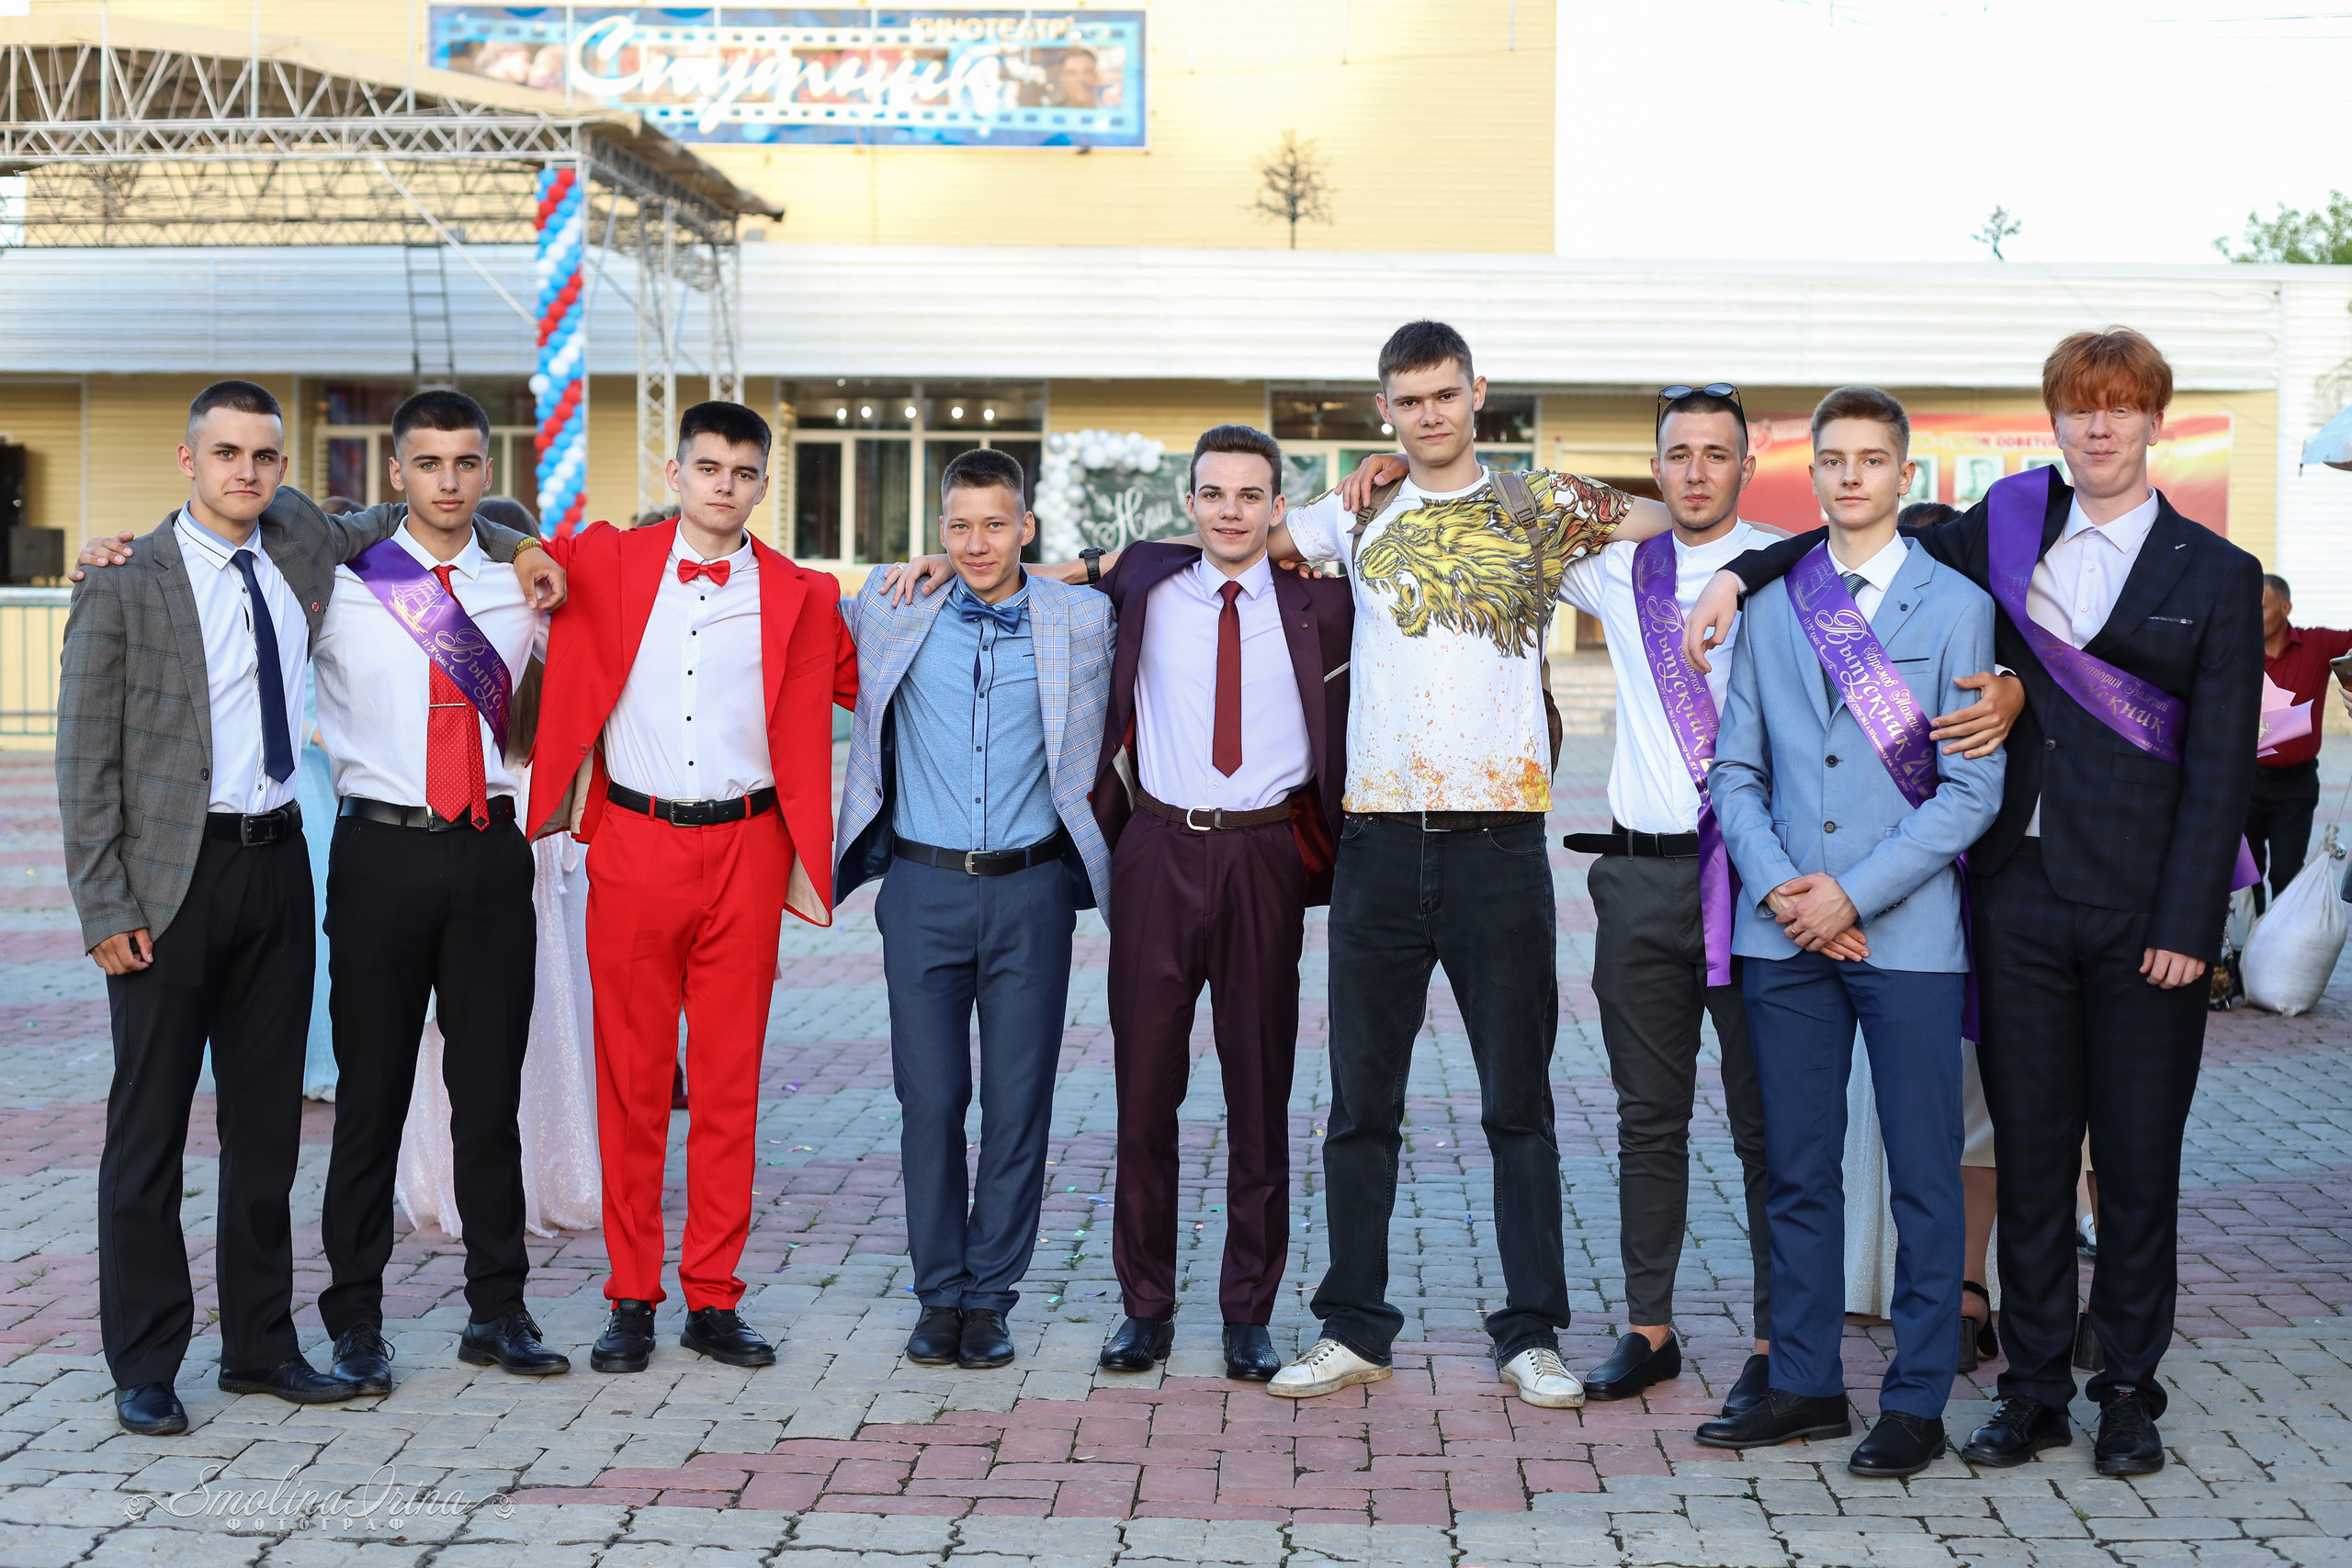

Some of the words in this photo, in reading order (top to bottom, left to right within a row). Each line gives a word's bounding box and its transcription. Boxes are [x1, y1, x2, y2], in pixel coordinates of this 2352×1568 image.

[910, 17, 1069, 40] КИНОТЕАТР
[422, 638, 428, 647] 11
[1646, 596, 1710, 756] Выпускник
[1815, 609, 1911, 761] Выпускник
[1862, 642, 1898, 688] Ефремов
[1890, 689, 1924, 736] Максим
[2125, 676, 2170, 713] Валерий
